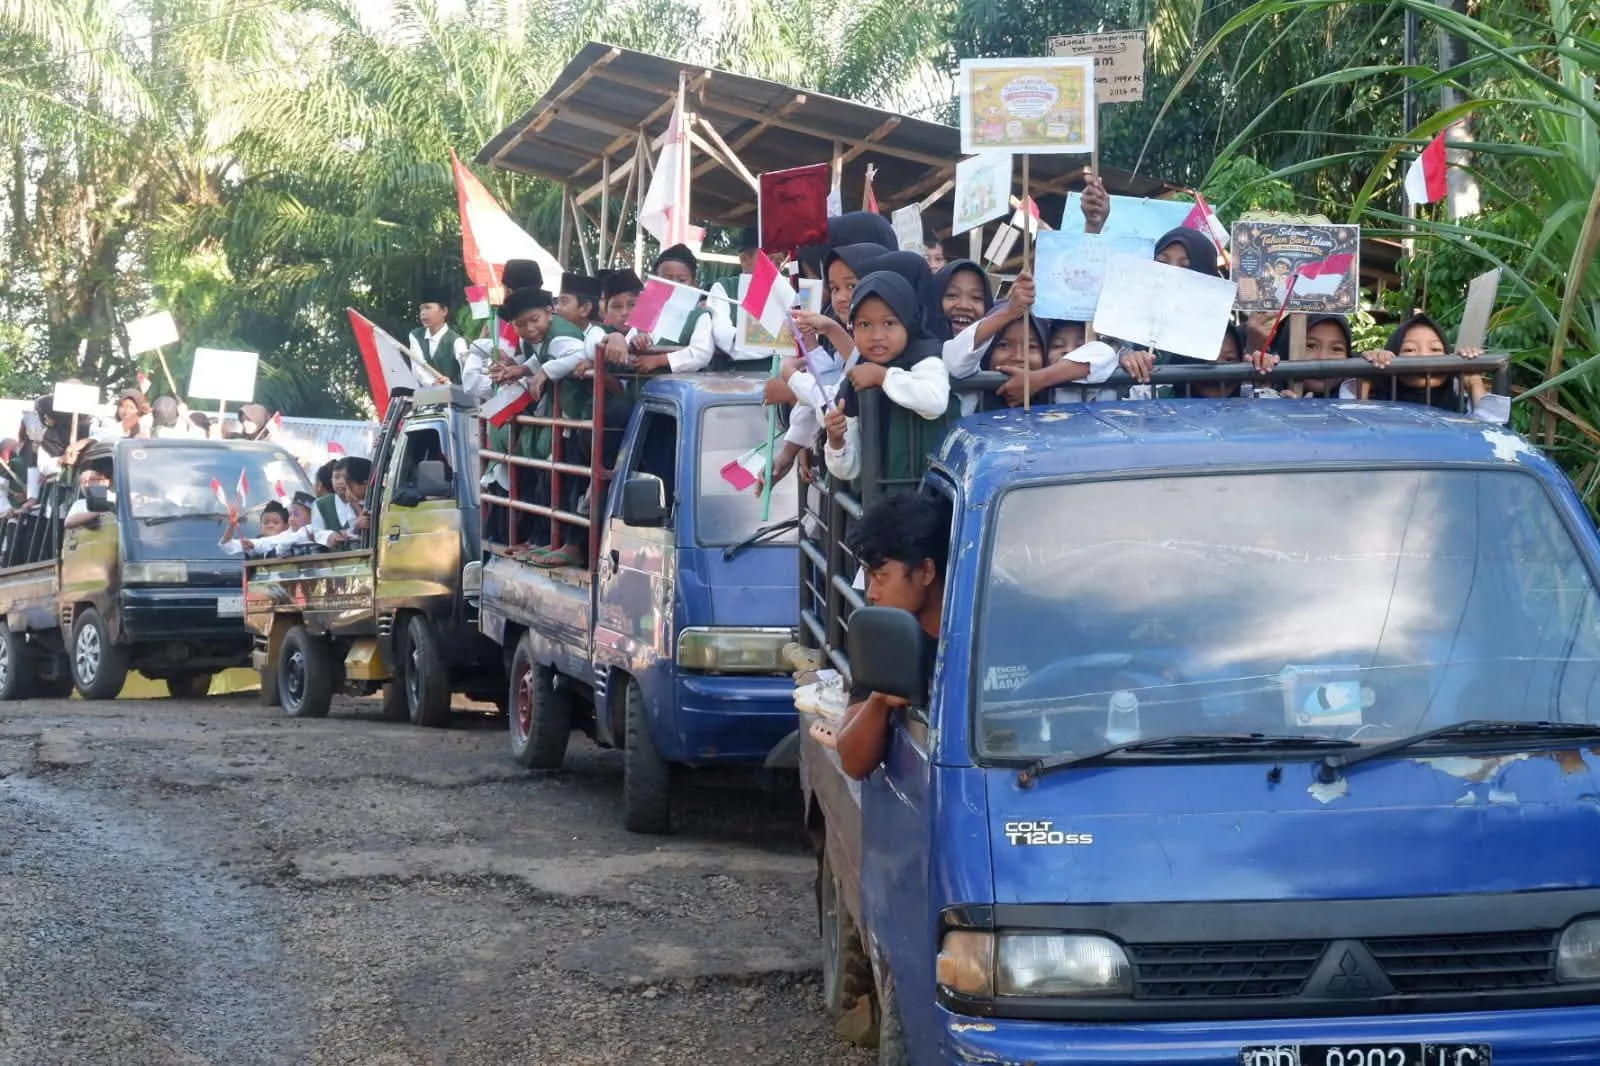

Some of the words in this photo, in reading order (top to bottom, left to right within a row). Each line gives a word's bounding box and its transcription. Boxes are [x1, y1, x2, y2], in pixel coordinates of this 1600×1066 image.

[1261, 233, 1288, 246] Tahun
[1310, 235, 1332, 247] Islam
[1005, 821, 1053, 832] COLT
